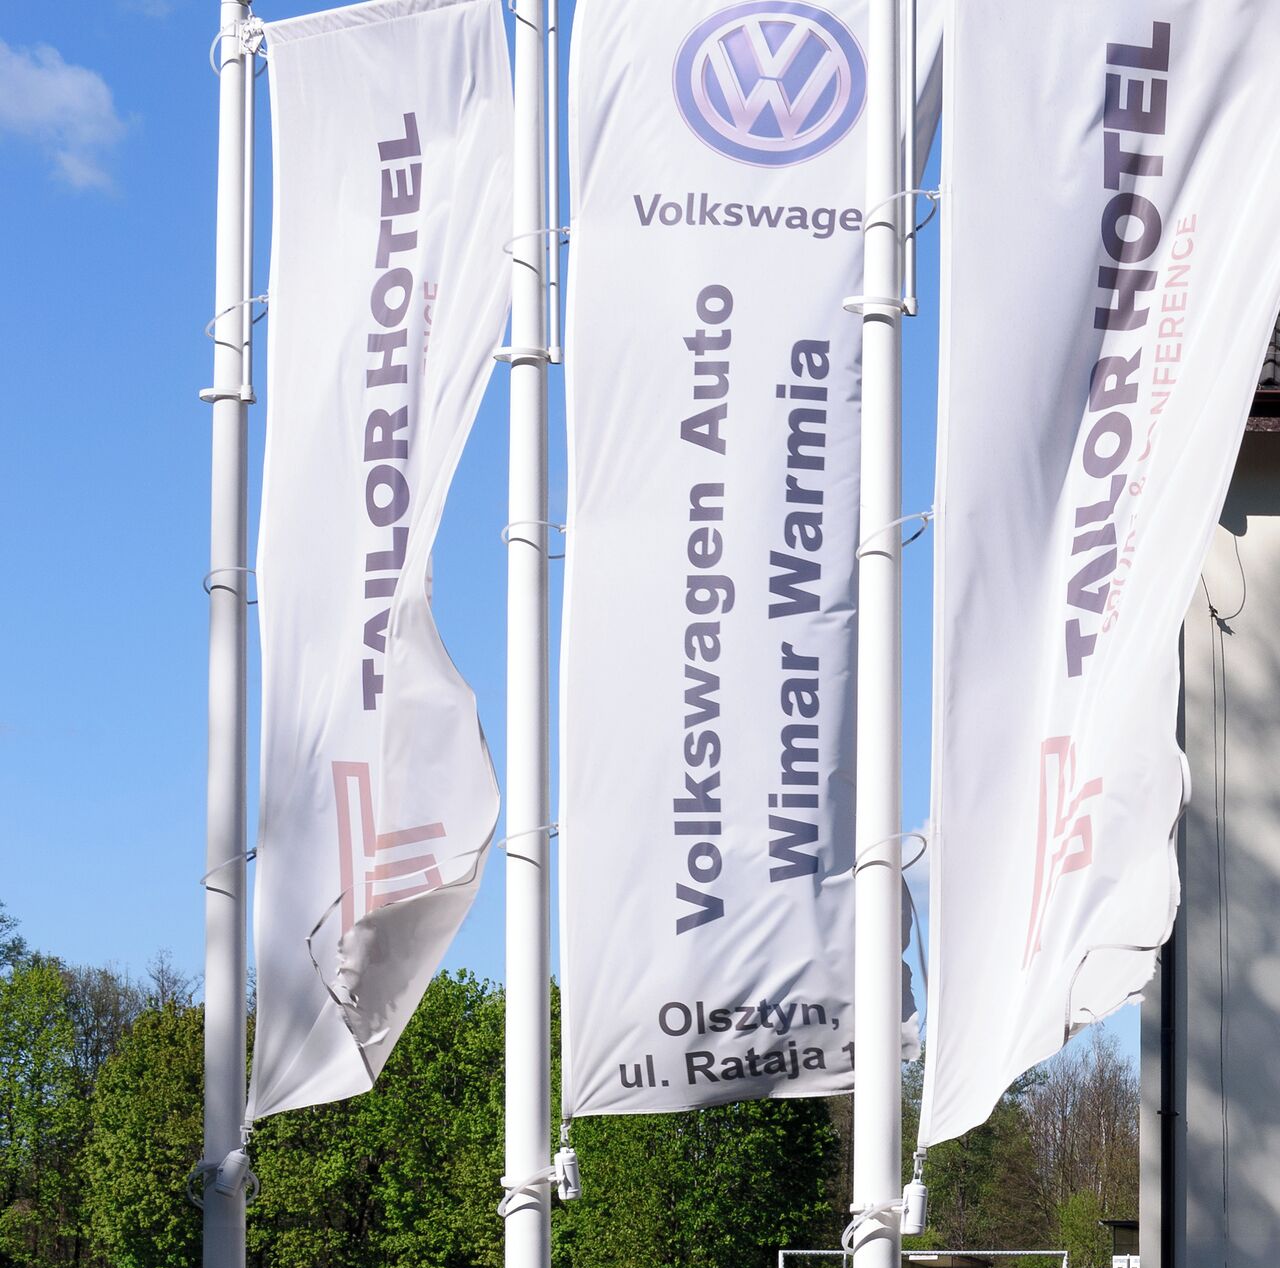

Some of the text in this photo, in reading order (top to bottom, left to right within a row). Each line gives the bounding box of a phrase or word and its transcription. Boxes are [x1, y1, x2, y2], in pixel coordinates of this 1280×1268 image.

[362, 112, 422, 710] TAILOR HOTEL
[633, 192, 862, 239] Volkswage
[1065, 21, 1171, 678] TAILOR HOTEL
[673, 284, 735, 936] Volkswagen Auto
[768, 339, 830, 882] Wimar Warmia
[619, 1054, 669, 1088] ul.
[685, 1041, 826, 1085] Rataja
[658, 998, 839, 1037] Olsztyn,
